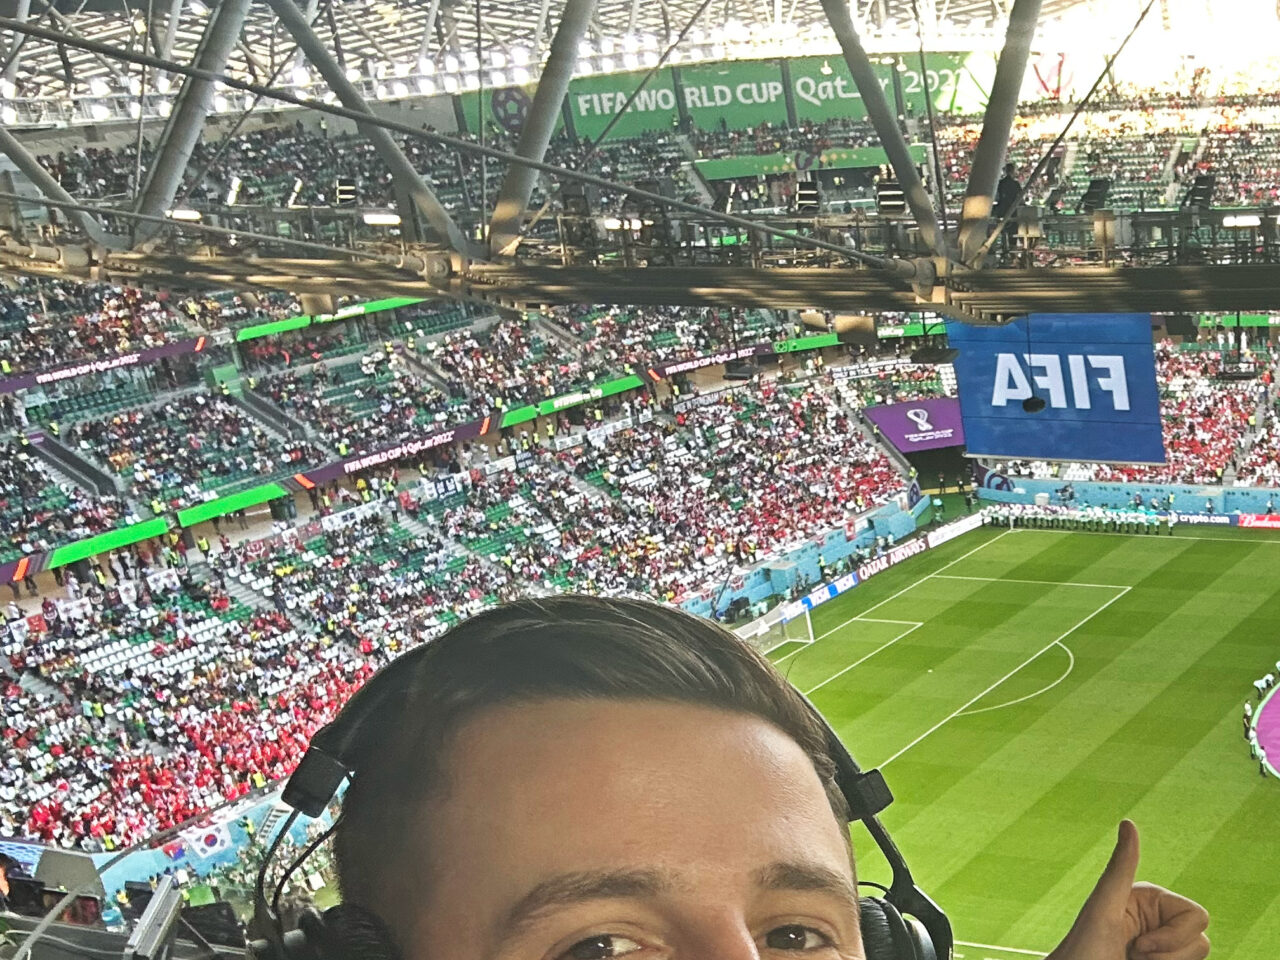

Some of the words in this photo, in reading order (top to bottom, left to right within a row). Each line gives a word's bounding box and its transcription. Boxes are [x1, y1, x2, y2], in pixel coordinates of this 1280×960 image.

[578, 92, 633, 116] FIFA
[634, 84, 732, 112] WORLD
[736, 81, 783, 104] CUP
[796, 75, 888, 107] Qatr
[344, 460, 362, 474] FIFA
[361, 451, 388, 468] WORLD
[387, 447, 401, 460] CUP
[1180, 513, 1230, 525] crypto.com
[859, 554, 889, 580] QATAR
[889, 539, 926, 565] AIRWAYS
